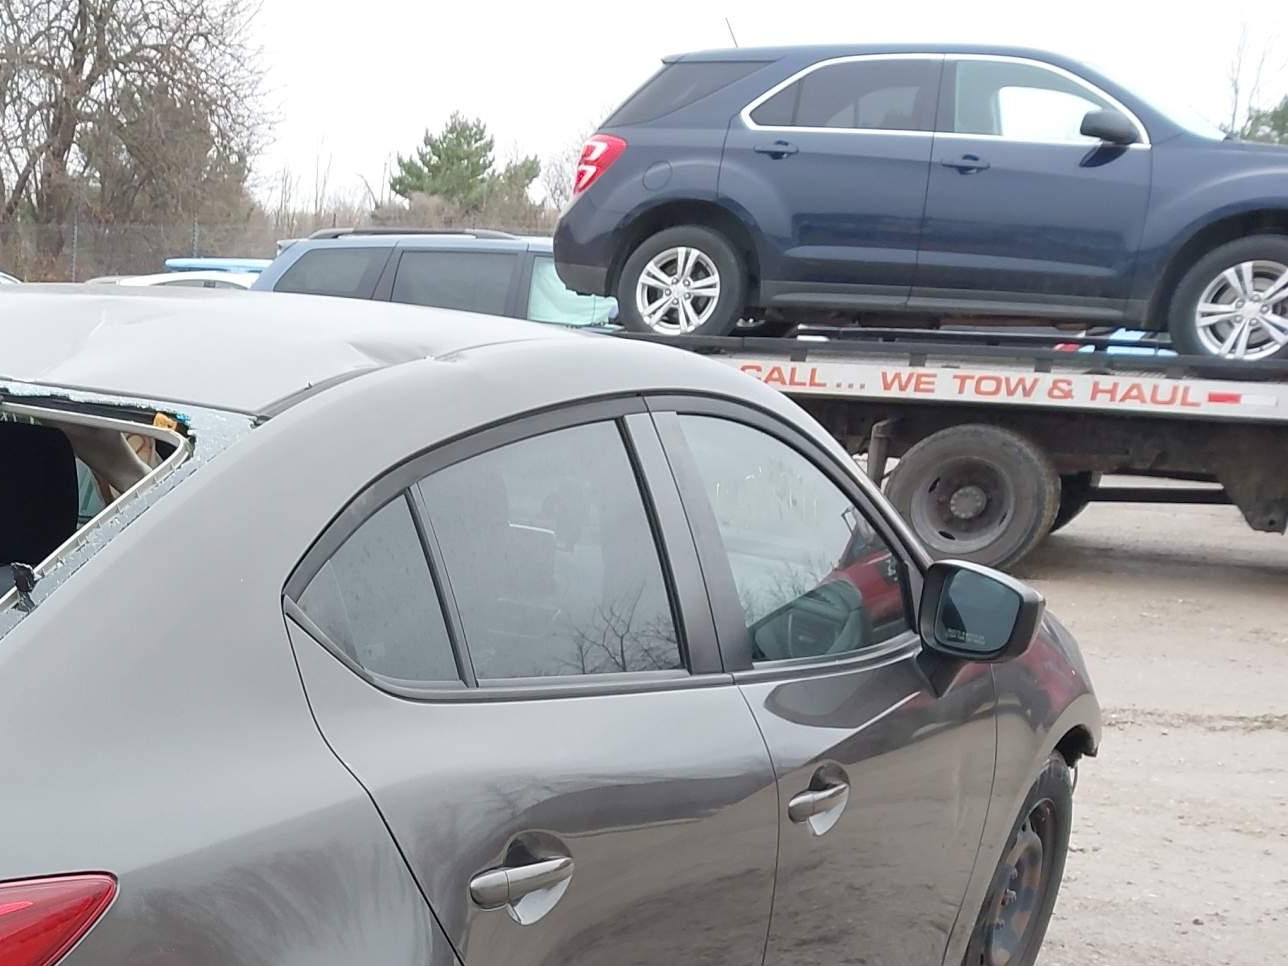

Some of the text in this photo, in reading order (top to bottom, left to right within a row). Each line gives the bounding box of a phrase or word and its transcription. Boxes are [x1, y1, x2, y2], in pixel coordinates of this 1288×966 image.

[881, 371, 938, 393] WE
[952, 374, 1040, 399] TOW
[1047, 378, 1074, 400] &
[1090, 380, 1201, 408] HAUL
